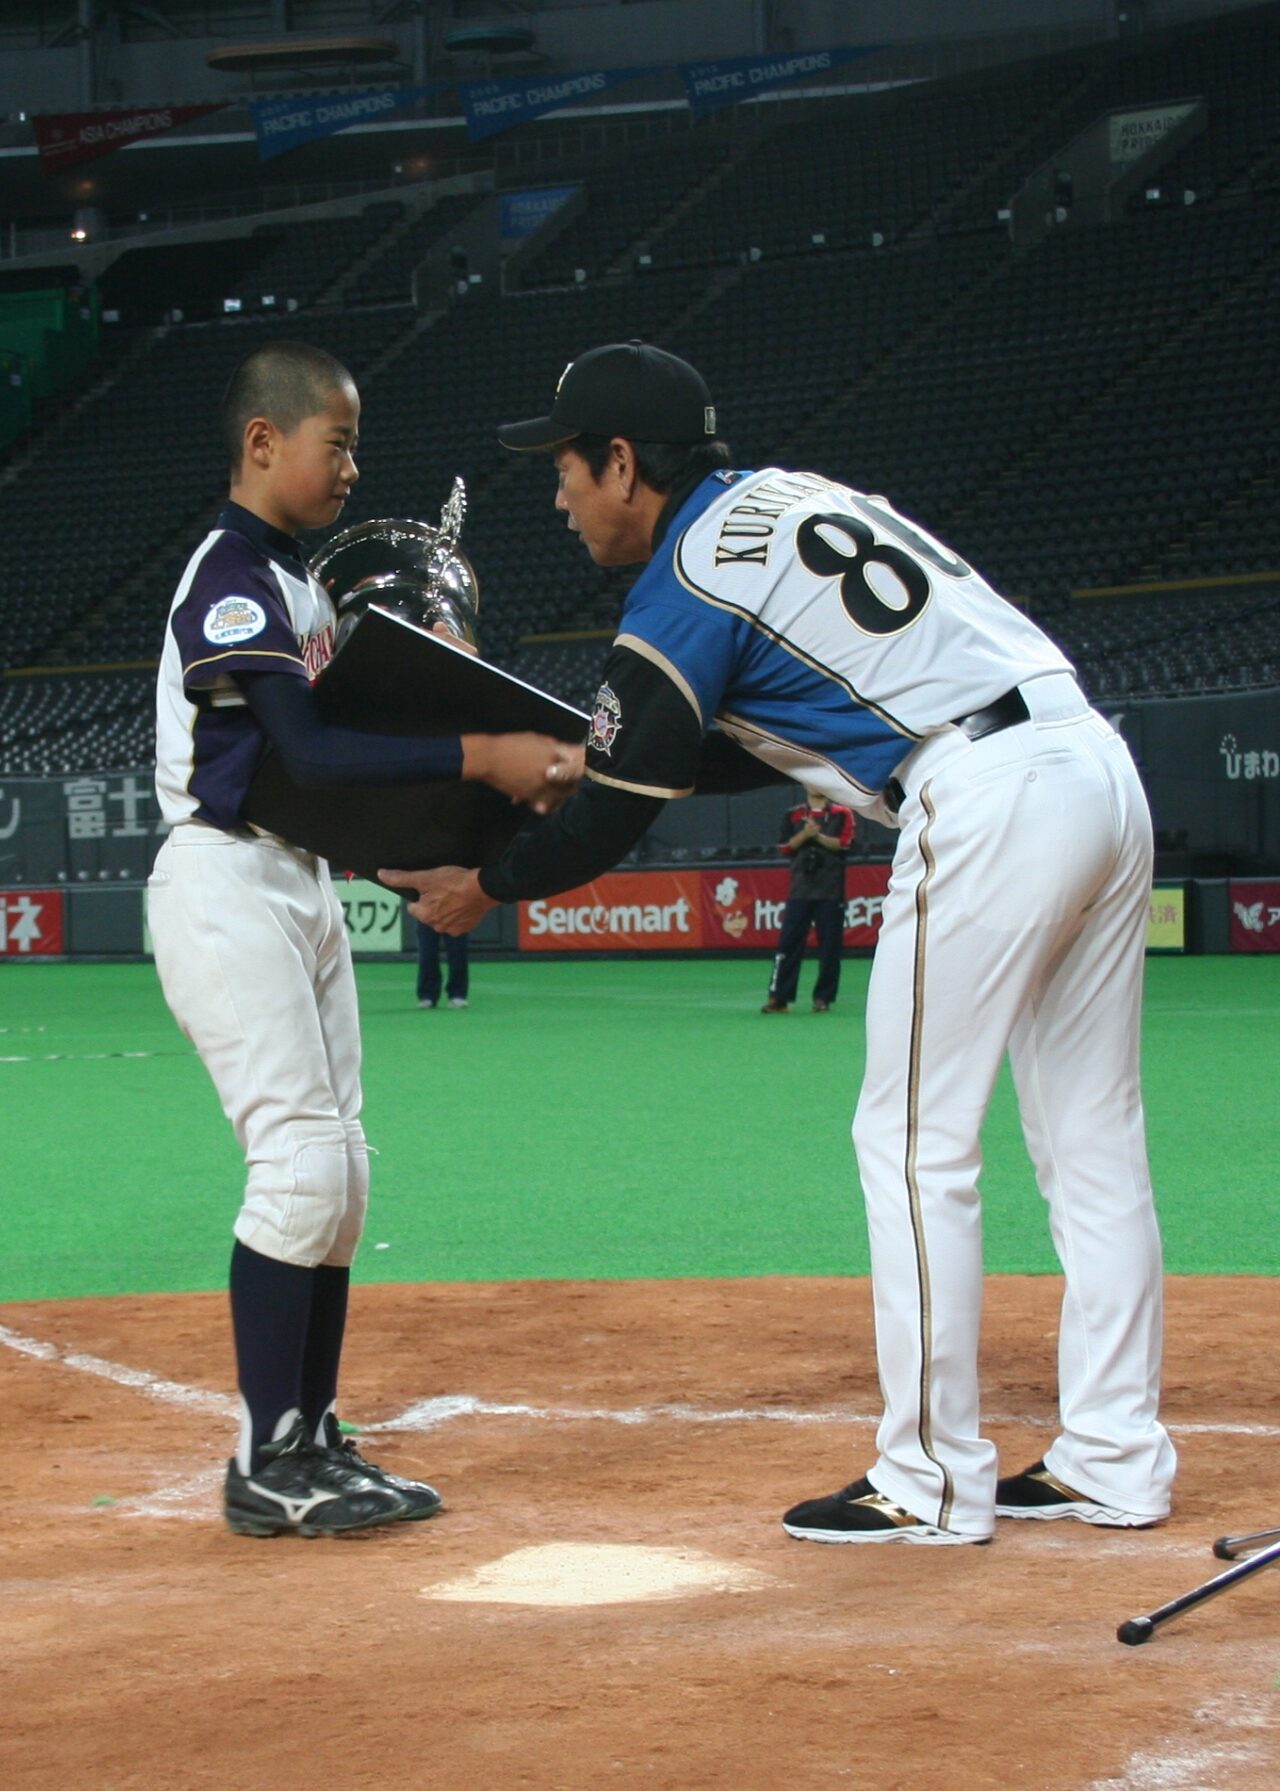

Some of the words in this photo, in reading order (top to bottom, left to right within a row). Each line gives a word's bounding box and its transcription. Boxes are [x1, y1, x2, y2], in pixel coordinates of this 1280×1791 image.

[472, 93, 522, 118] PACIFIC
[526, 73, 607, 106] CHAMPIONS
[694, 72, 745, 97] PACIFIC
[748, 52, 832, 84] CHAMPIONS
[79, 125, 105, 144] ASIA
[104, 109, 174, 139] CHAMPIONS
[262, 111, 313, 137] PACIFIC
[315, 92, 396, 124] CHAMPIONS
[63, 777, 174, 839] 富士
[527, 896, 691, 935] Seicomart
